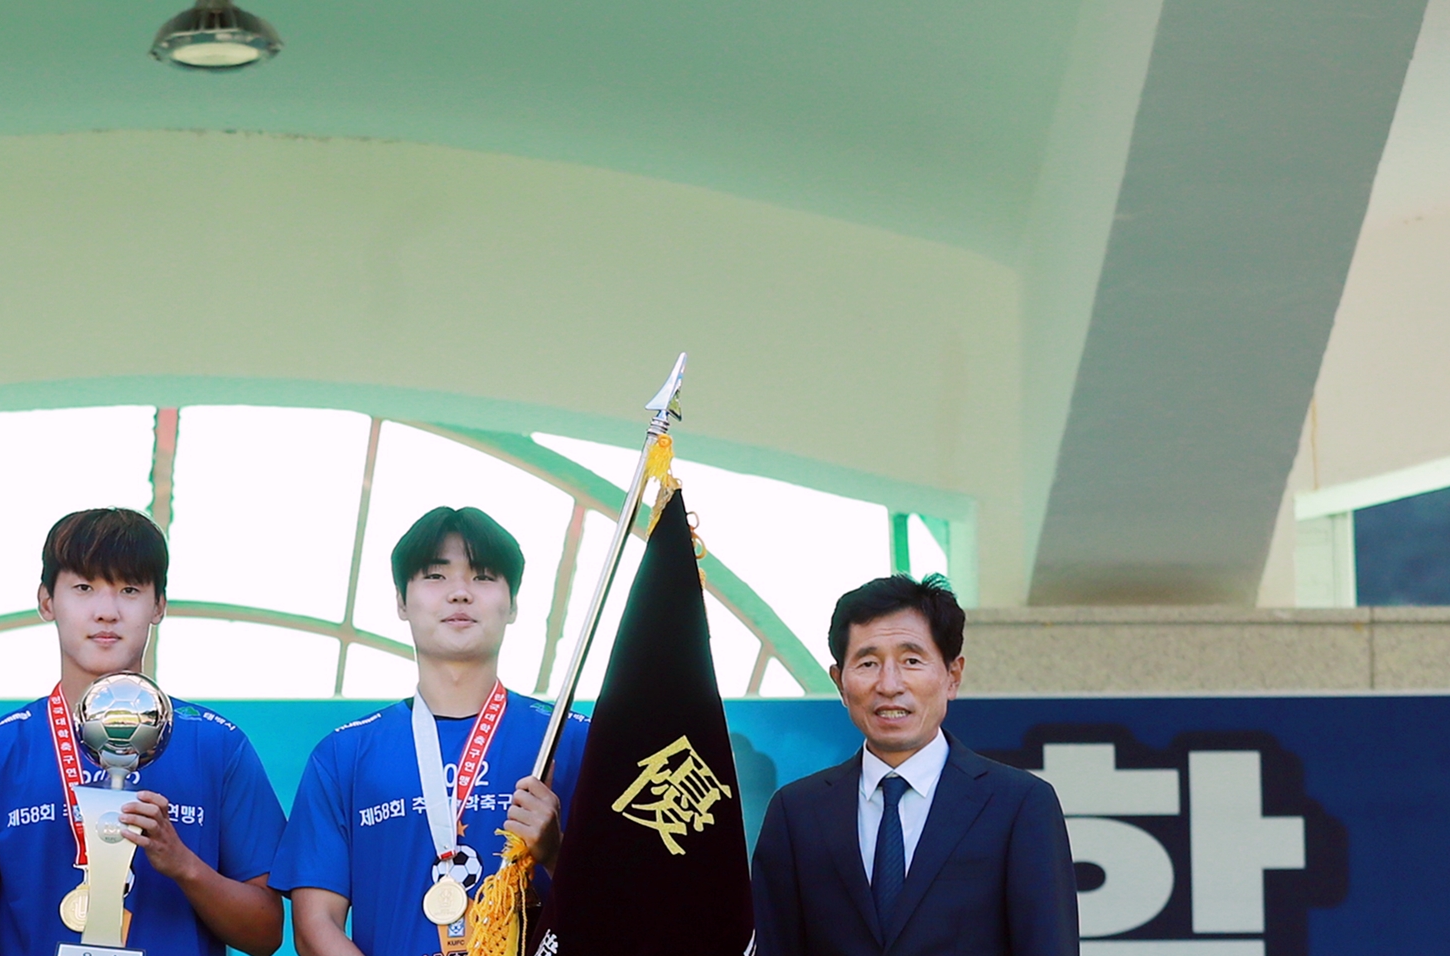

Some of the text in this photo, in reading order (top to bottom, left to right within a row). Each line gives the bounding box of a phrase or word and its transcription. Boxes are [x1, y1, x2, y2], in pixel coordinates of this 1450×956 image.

[611, 735, 733, 856] 優
[7, 803, 56, 828] 제58회
[359, 799, 405, 827] 제58회
